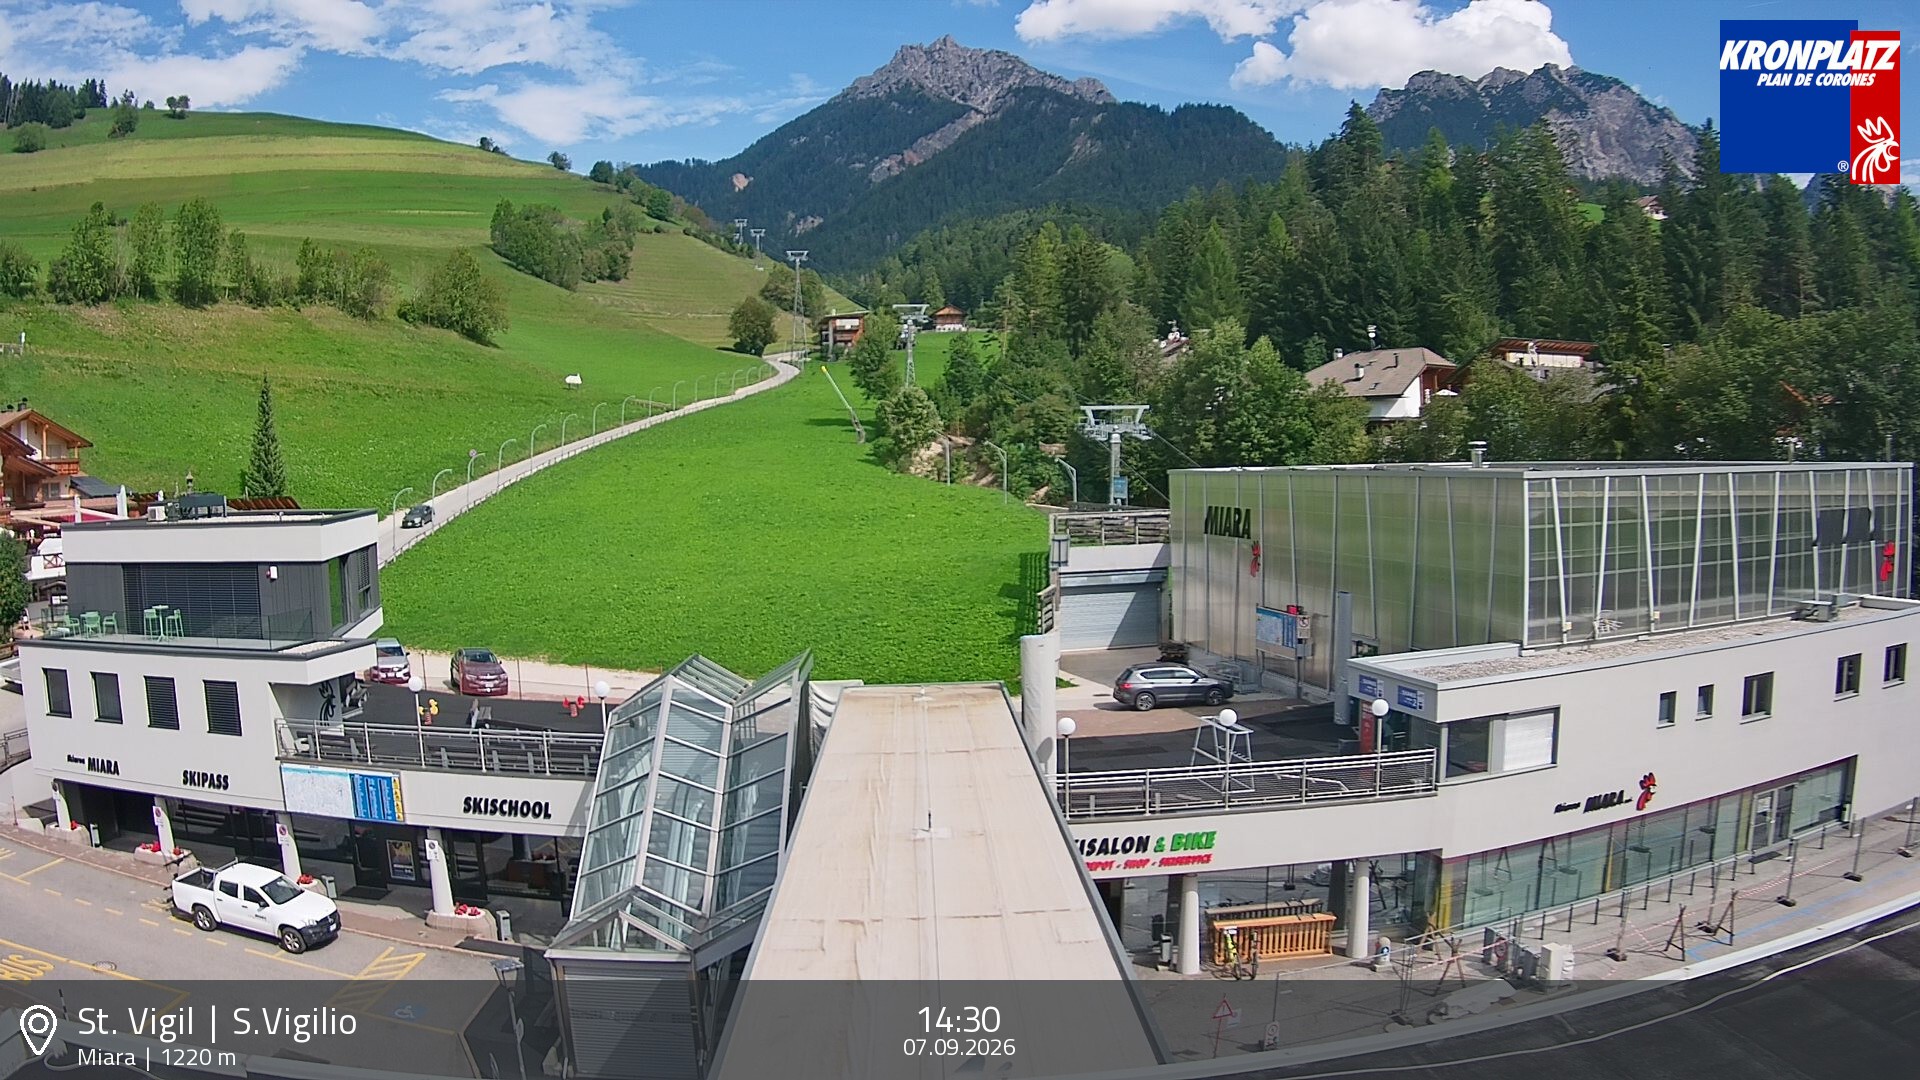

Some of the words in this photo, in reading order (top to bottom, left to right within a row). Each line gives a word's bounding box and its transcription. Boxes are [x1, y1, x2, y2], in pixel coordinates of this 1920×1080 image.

[1204, 506, 1252, 539] MIARA
[88, 757, 120, 776] MIARA
[183, 770, 229, 790] SKIPASS
[463, 796, 552, 819] SKISCHOOL
[1583, 790, 1625, 814] MIARA
[1154, 837, 1166, 853] &
[1171, 831, 1217, 852] BIKE
